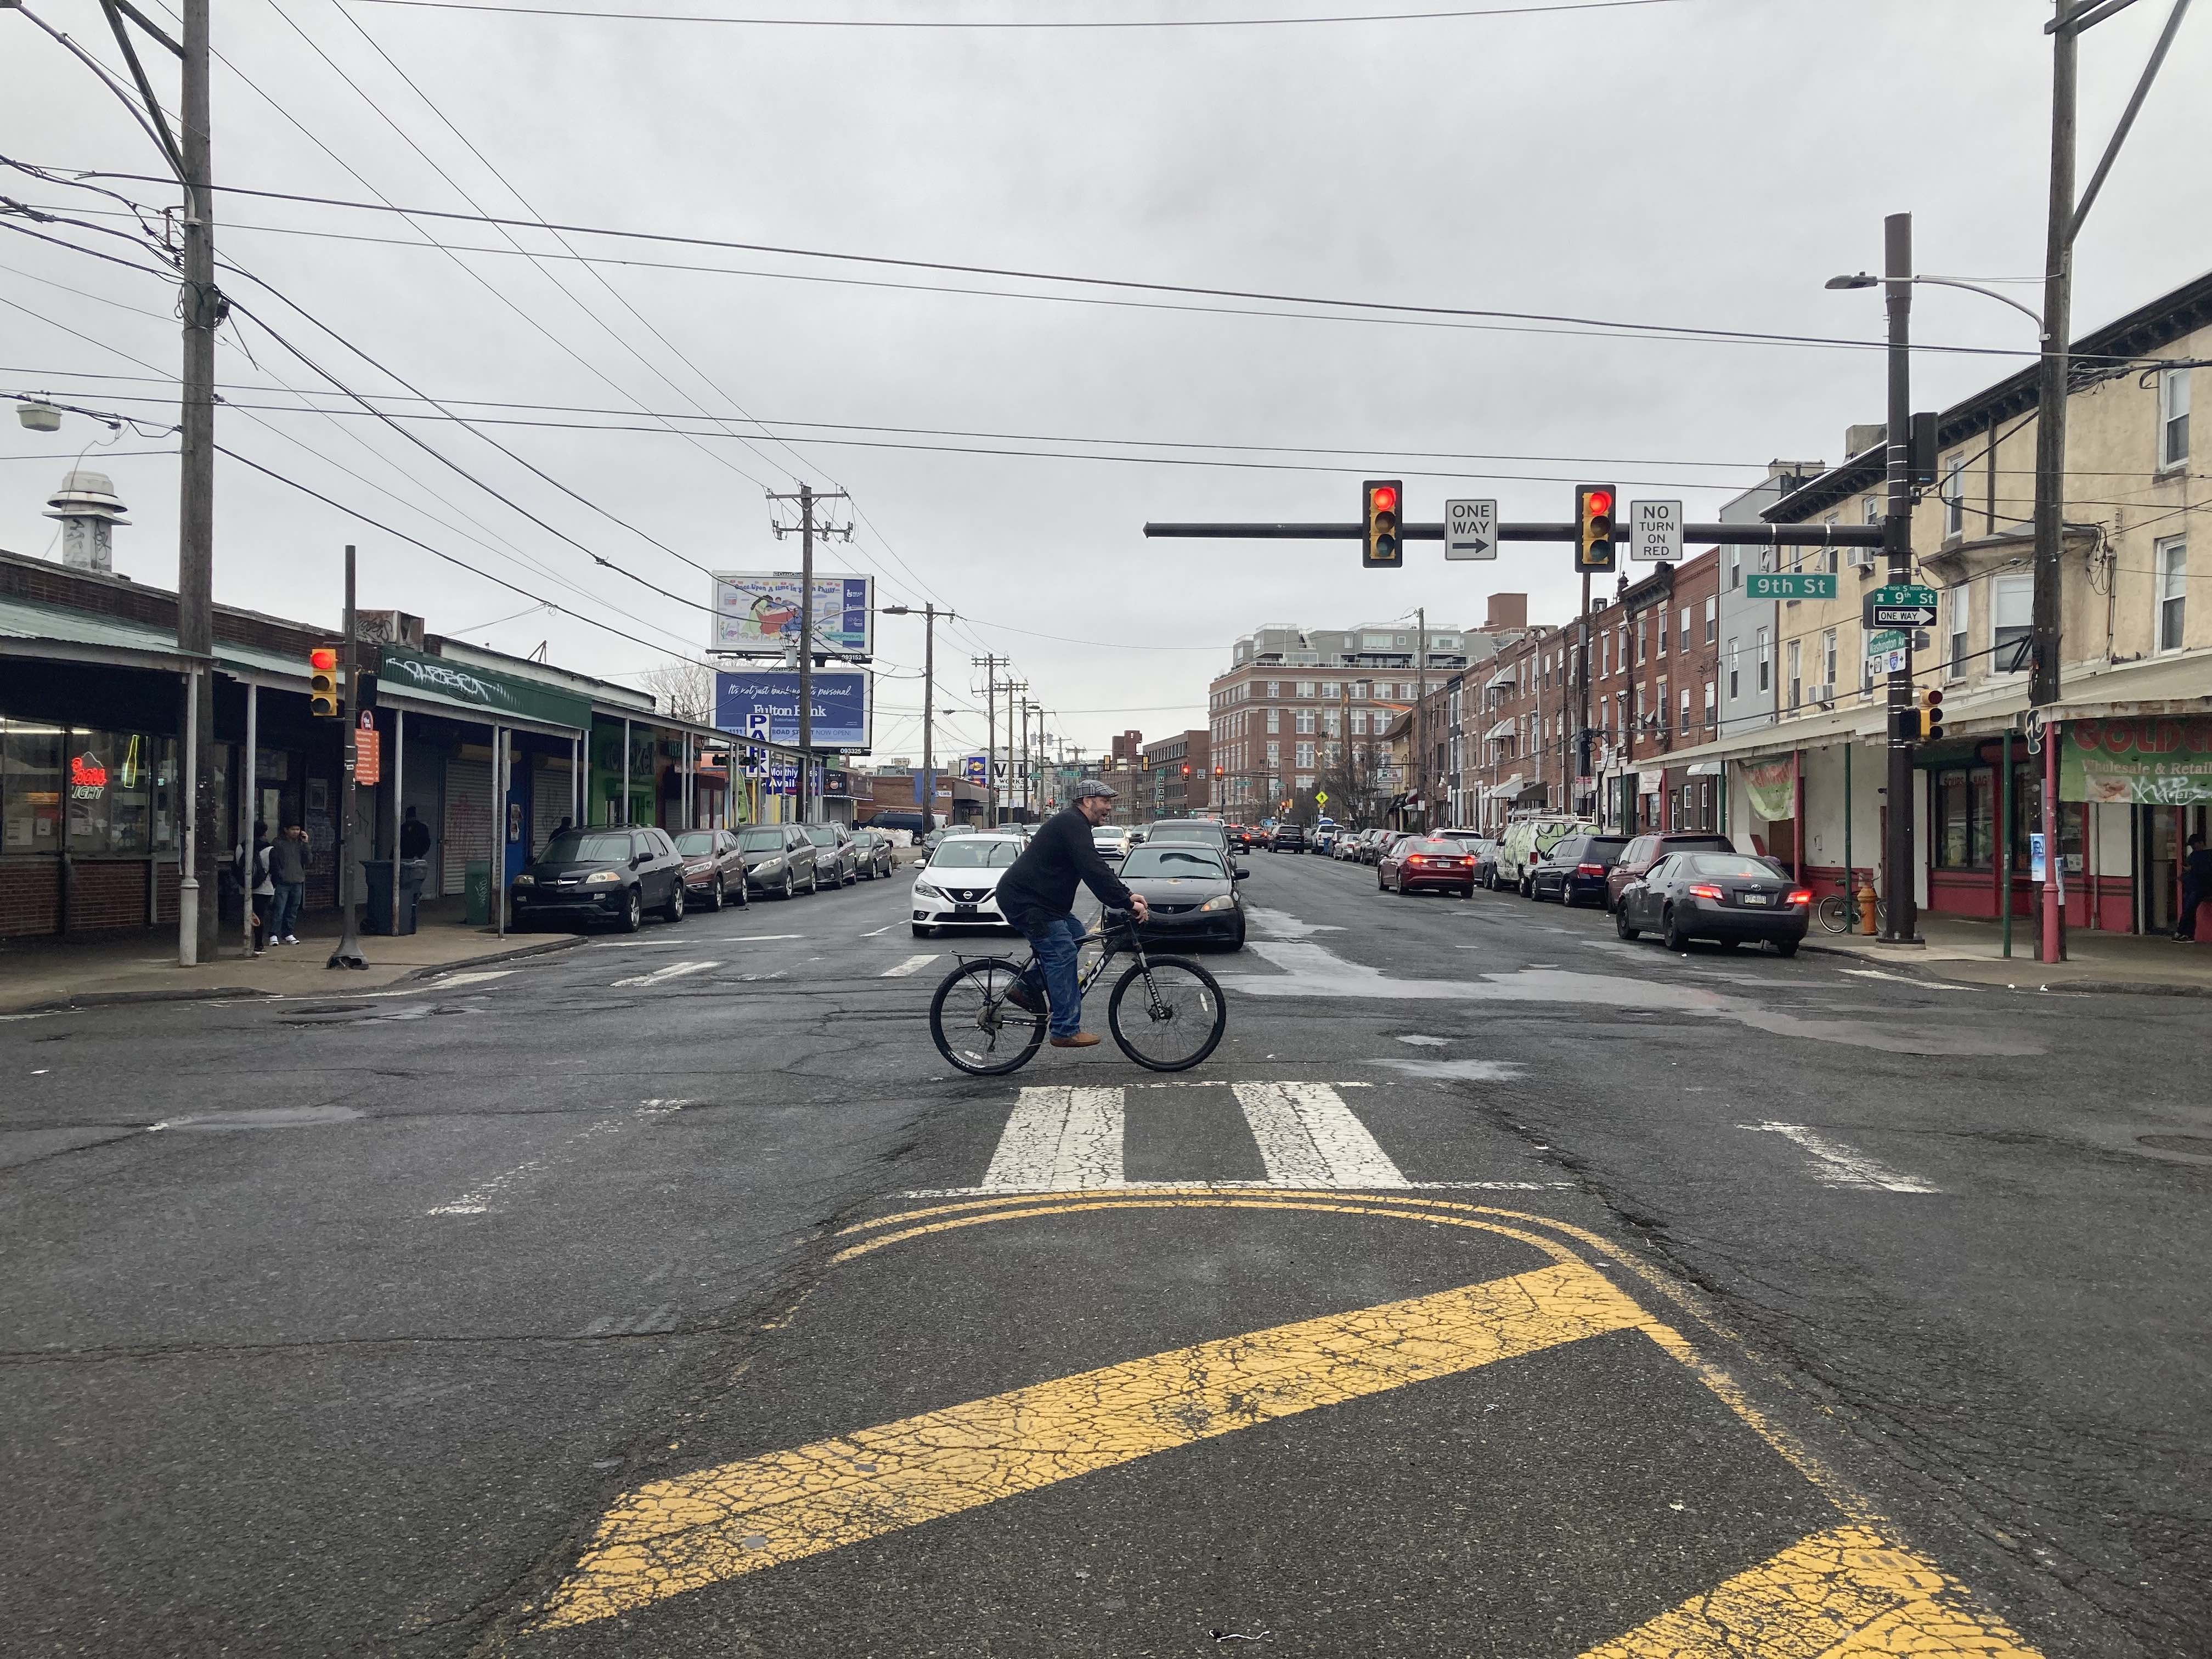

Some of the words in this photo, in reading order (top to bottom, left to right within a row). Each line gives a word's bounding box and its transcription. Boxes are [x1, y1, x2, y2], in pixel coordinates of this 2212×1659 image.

[1452, 505, 1490, 518] ONE
[1644, 506, 1669, 519] NO
[1452, 521, 1490, 534] WAY
[1639, 522, 1674, 532] TURN
[1647, 534, 1666, 544] ON
[1643, 546, 1669, 556] RED
[1757, 578, 1793, 594] 9th
[1803, 579, 1826, 594] St
[1895, 591, 1911, 604] 9th
[1920, 592, 1934, 604] St
[1881, 612, 1897, 620] ONE
[1900, 612, 1918, 620] WAY
[1869, 638, 1897, 654] Washington
[1898, 636, 1905, 647] Av
[754, 704, 793, 716] Fulton
[794, 705, 827, 717] Bnk
[2074, 716, 2212, 754] GOLDE
[771, 769, 798, 778] Monthly
[2081, 759, 2151, 774] Wholesale
[2154, 763, 2166, 775] &
